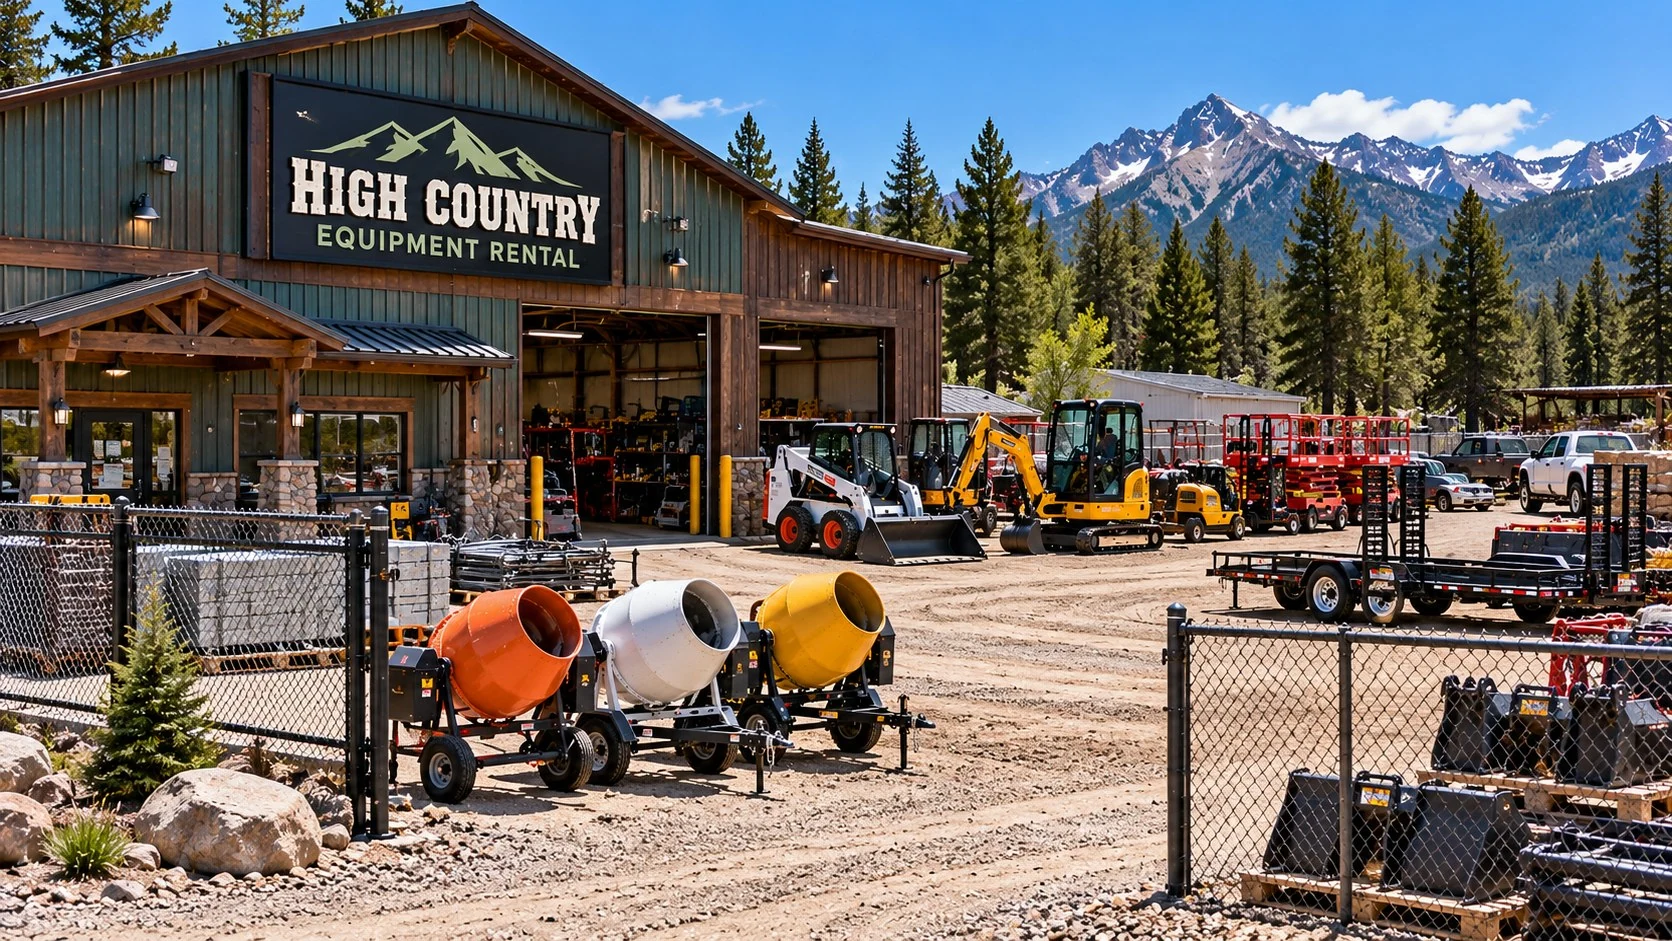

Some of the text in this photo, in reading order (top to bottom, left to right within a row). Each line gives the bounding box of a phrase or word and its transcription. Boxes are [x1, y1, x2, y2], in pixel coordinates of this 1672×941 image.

[291, 156, 600, 245] HIGH COUNTRY
[317, 223, 580, 269] EQUIPMENT RENTAL
